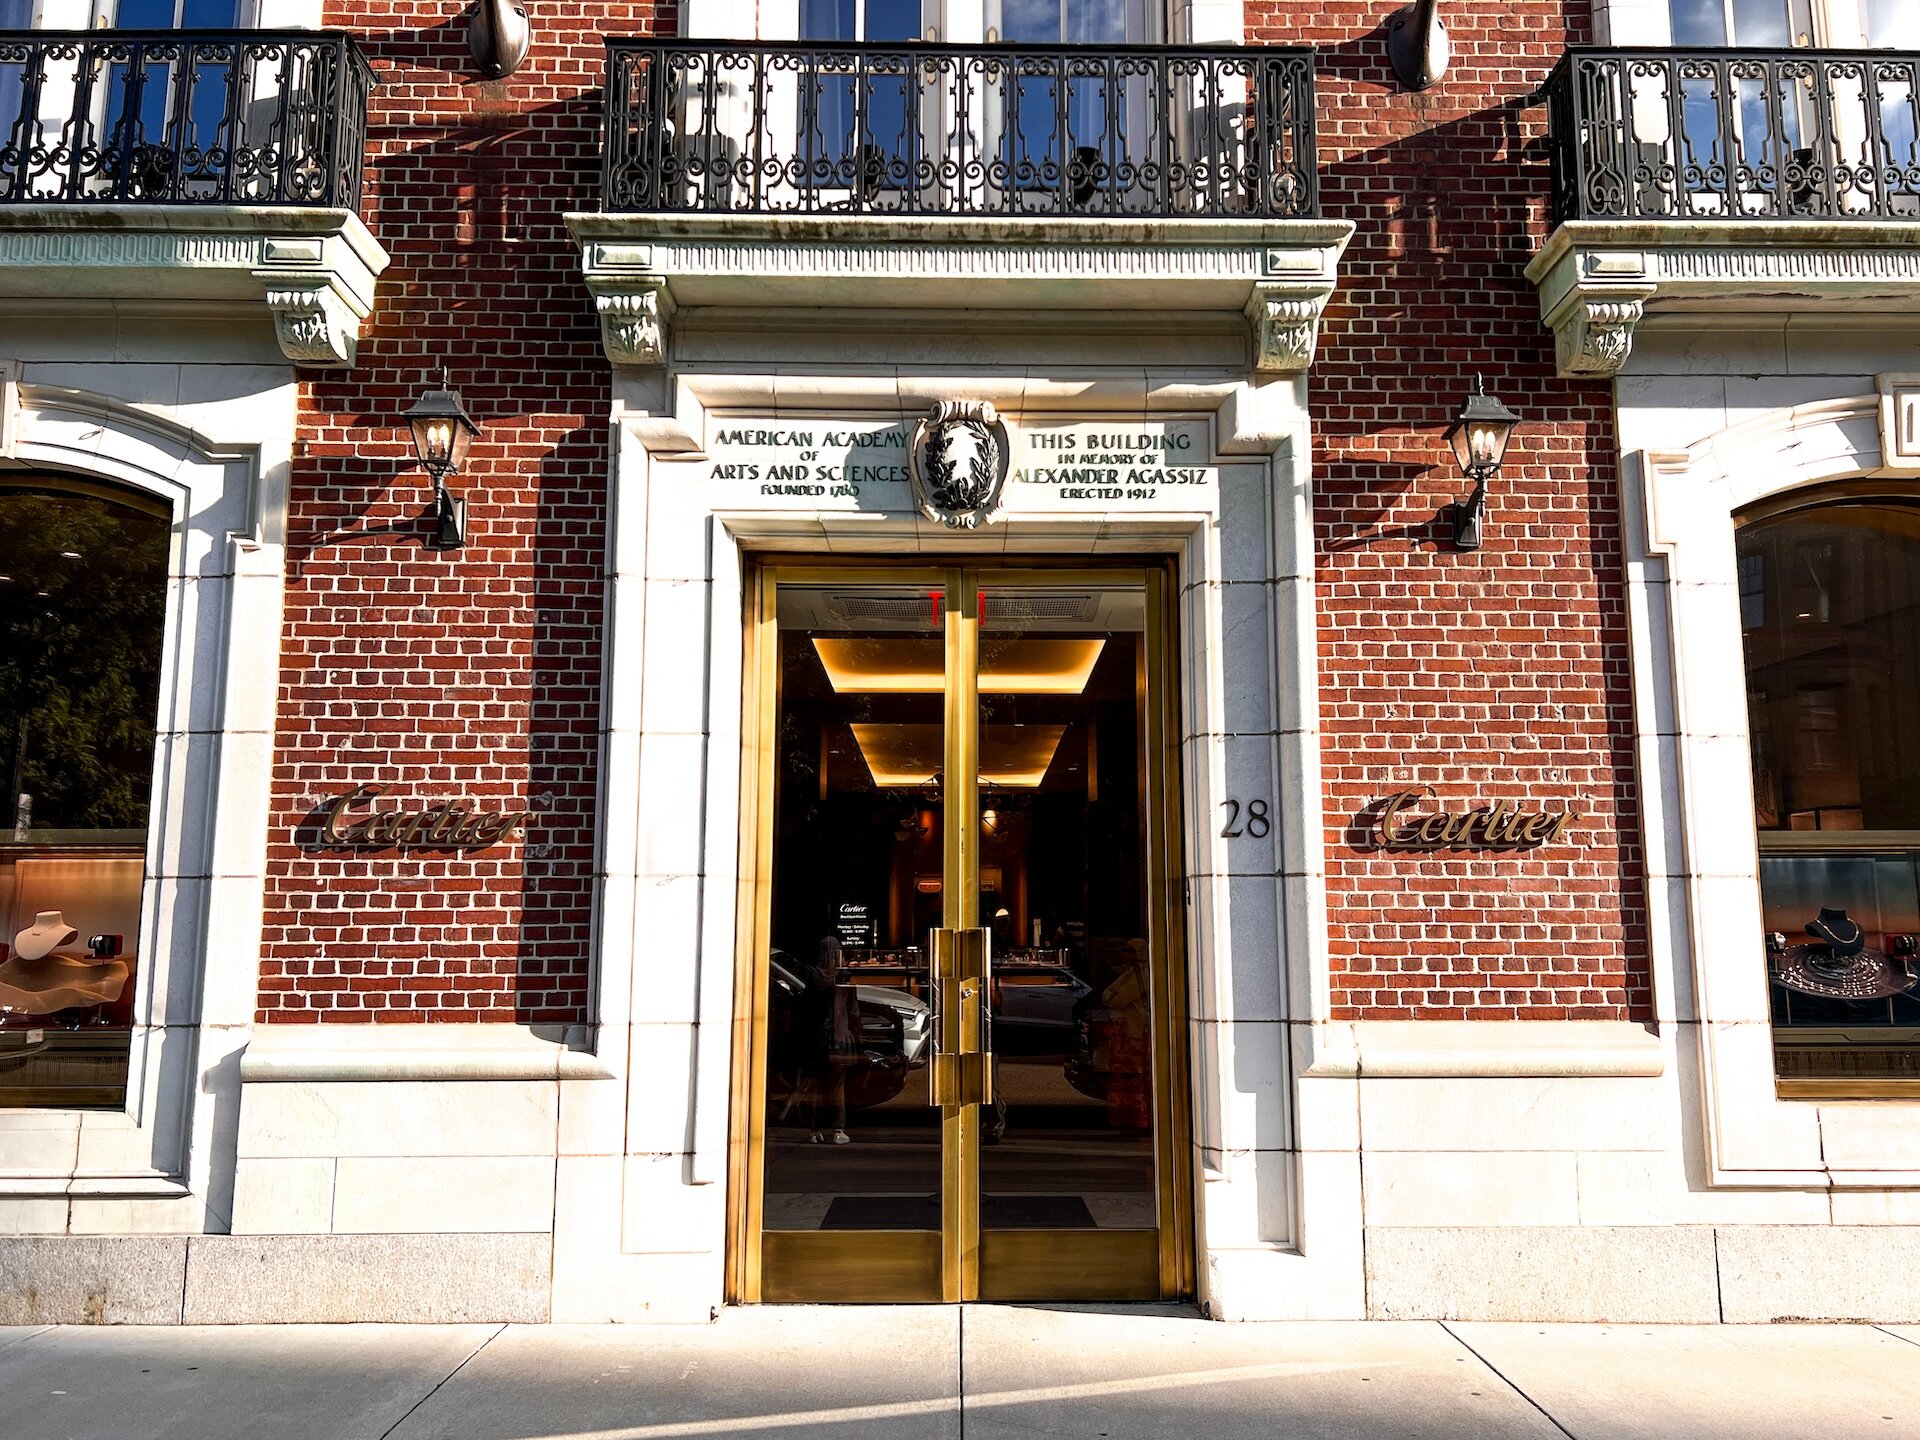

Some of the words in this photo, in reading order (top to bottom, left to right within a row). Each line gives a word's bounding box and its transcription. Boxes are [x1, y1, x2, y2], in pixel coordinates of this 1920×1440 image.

[714, 429, 813, 447] AMERICAN
[821, 431, 910, 448] ACADEMY
[1029, 433, 1076, 449] THIS
[1086, 433, 1191, 450] BUILDING
[799, 451, 819, 461] OF
[1057, 454, 1075, 464] IN
[1079, 454, 1137, 464] MEMORY
[1139, 454, 1159, 465] OF
[710, 464, 759, 480] ARTS
[765, 465, 810, 481] AND
[815, 465, 910, 482] SCIENCES
[1012, 469, 1119, 484] ALEXANDER
[1125, 469, 1208, 485] AGASSIZ
[760, 484, 825, 496] FOUNDED
[829, 485, 860, 498] 1780
[1060, 488, 1124, 499] ERECTED
[1126, 488, 1157, 500] 1912
[322, 783, 538, 844] Cartier
[1219, 799, 1271, 839] 28
[1381, 785, 1585, 843] Cartier
[840, 903, 867, 912] Cartier
